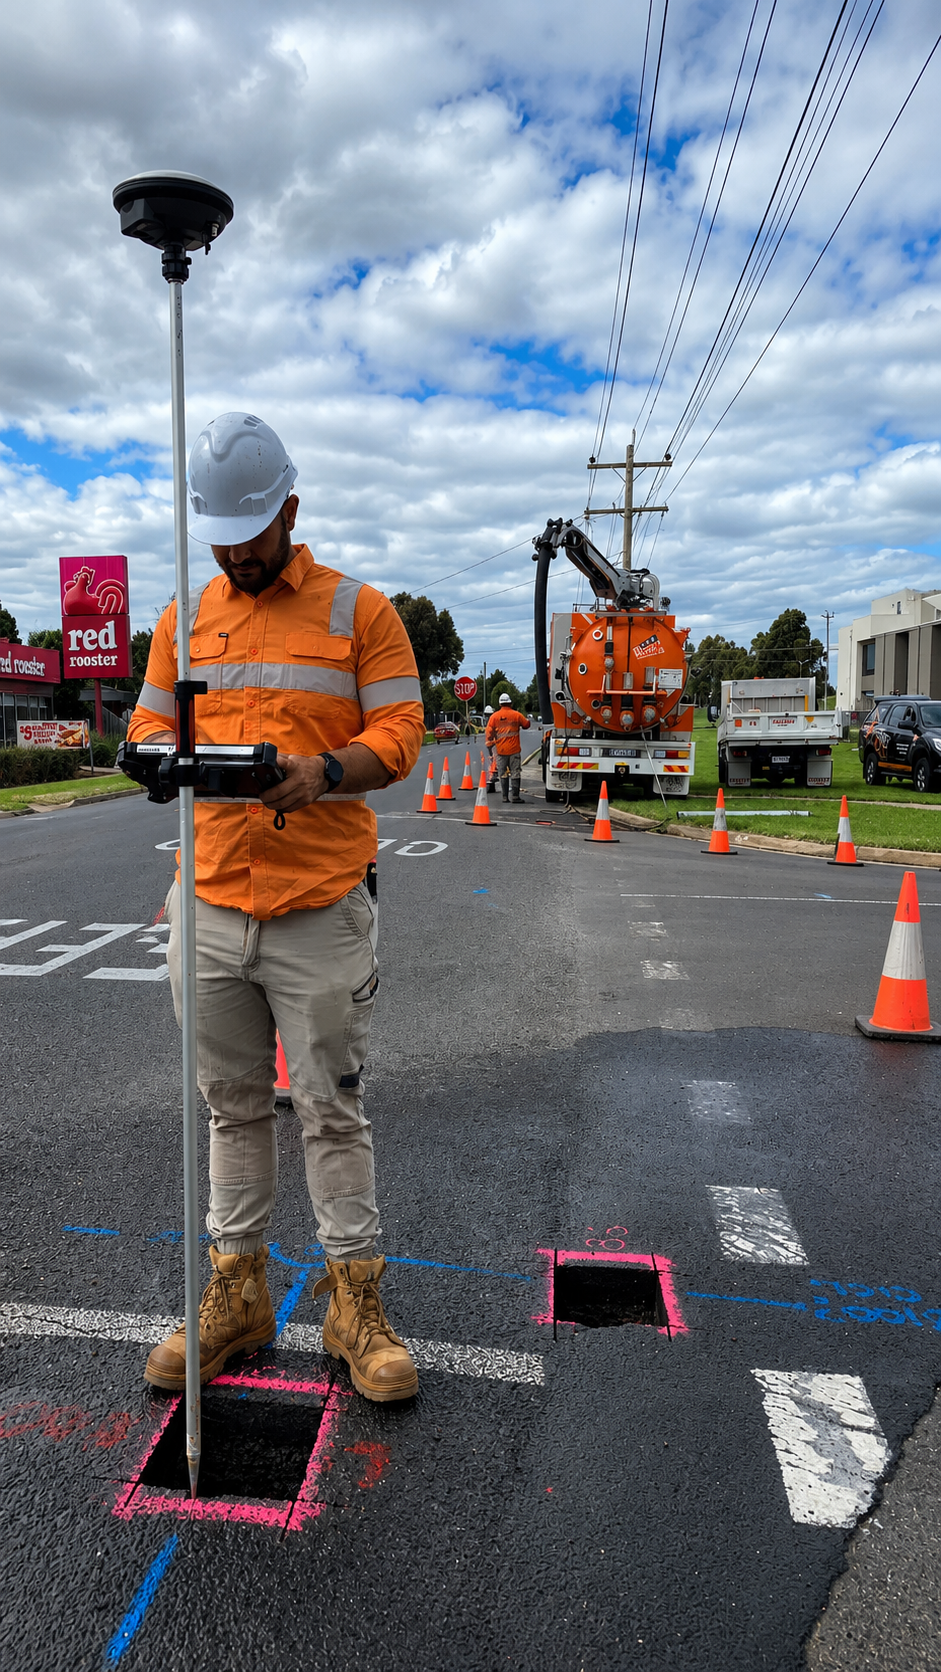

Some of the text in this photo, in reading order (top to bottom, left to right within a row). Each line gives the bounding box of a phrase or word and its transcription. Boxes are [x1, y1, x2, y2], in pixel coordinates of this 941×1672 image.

[67, 620, 118, 651] red
[0, 650, 12, 673] ed
[69, 653, 118, 667] rooster
[454, 682, 475, 695] STOP
